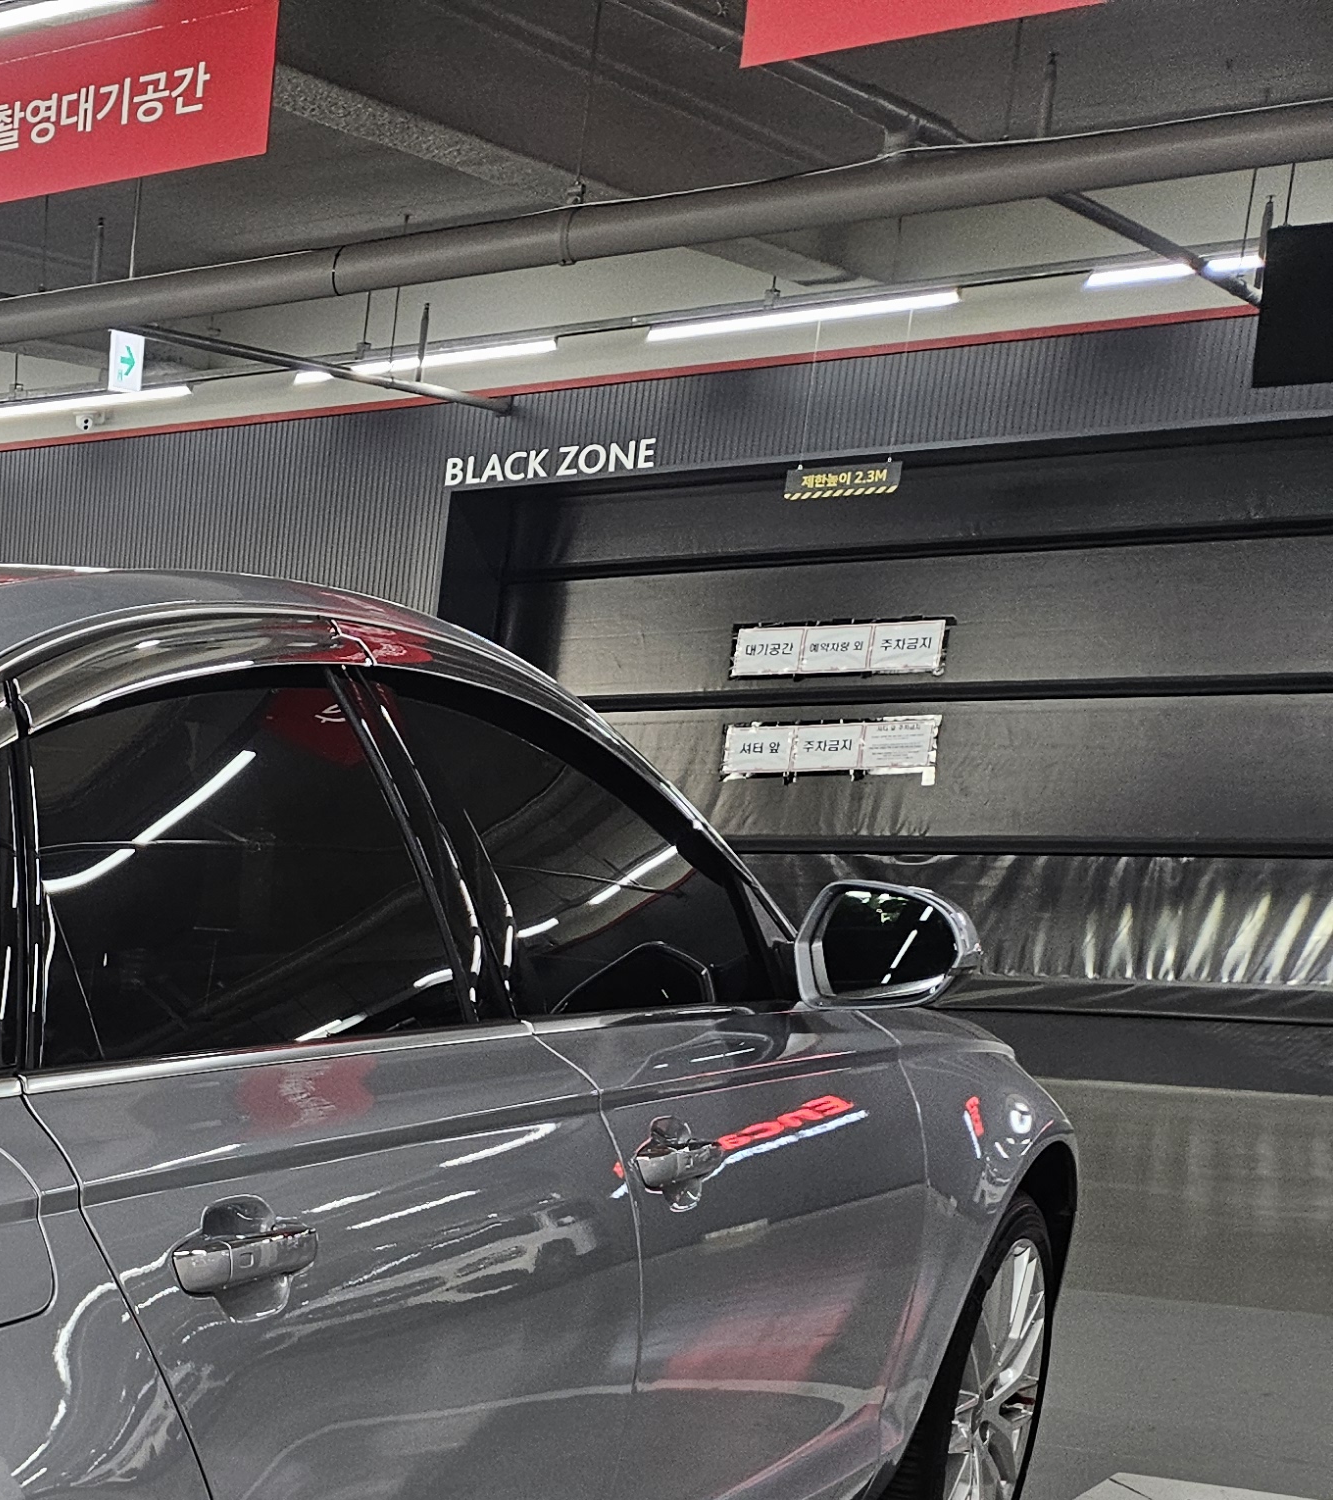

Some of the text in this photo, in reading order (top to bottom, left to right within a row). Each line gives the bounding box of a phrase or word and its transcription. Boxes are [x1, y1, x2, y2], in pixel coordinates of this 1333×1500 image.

[444, 437, 657, 486] BLACK ZONE
[801, 469, 888, 489] 제한높이 2.3M
[745, 642, 794, 656] 대기공간
[880, 637, 932, 651] 주차금지
[740, 738, 852, 754] 셔터 앞 주차금지
